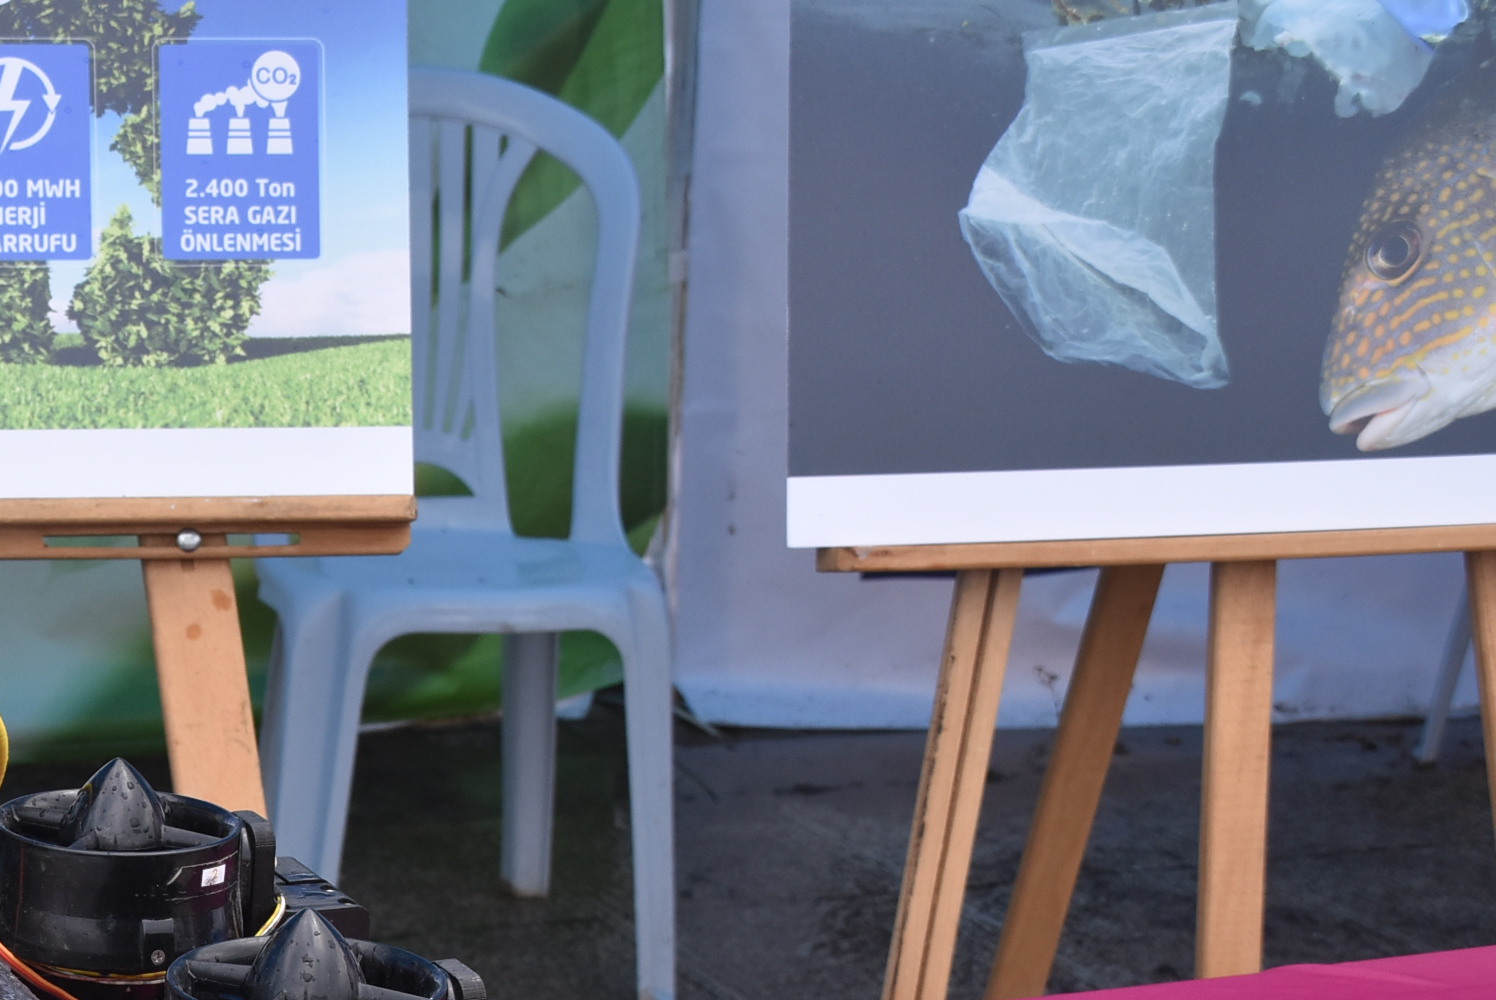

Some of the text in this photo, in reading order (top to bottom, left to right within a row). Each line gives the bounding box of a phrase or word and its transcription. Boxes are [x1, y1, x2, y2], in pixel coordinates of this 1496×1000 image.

[26, 179, 81, 198] MWH
[185, 178, 295, 198] 2.400 Ton
[184, 206, 296, 225] SERA GAZI
[180, 228, 301, 252] ÖNLENMESİ
